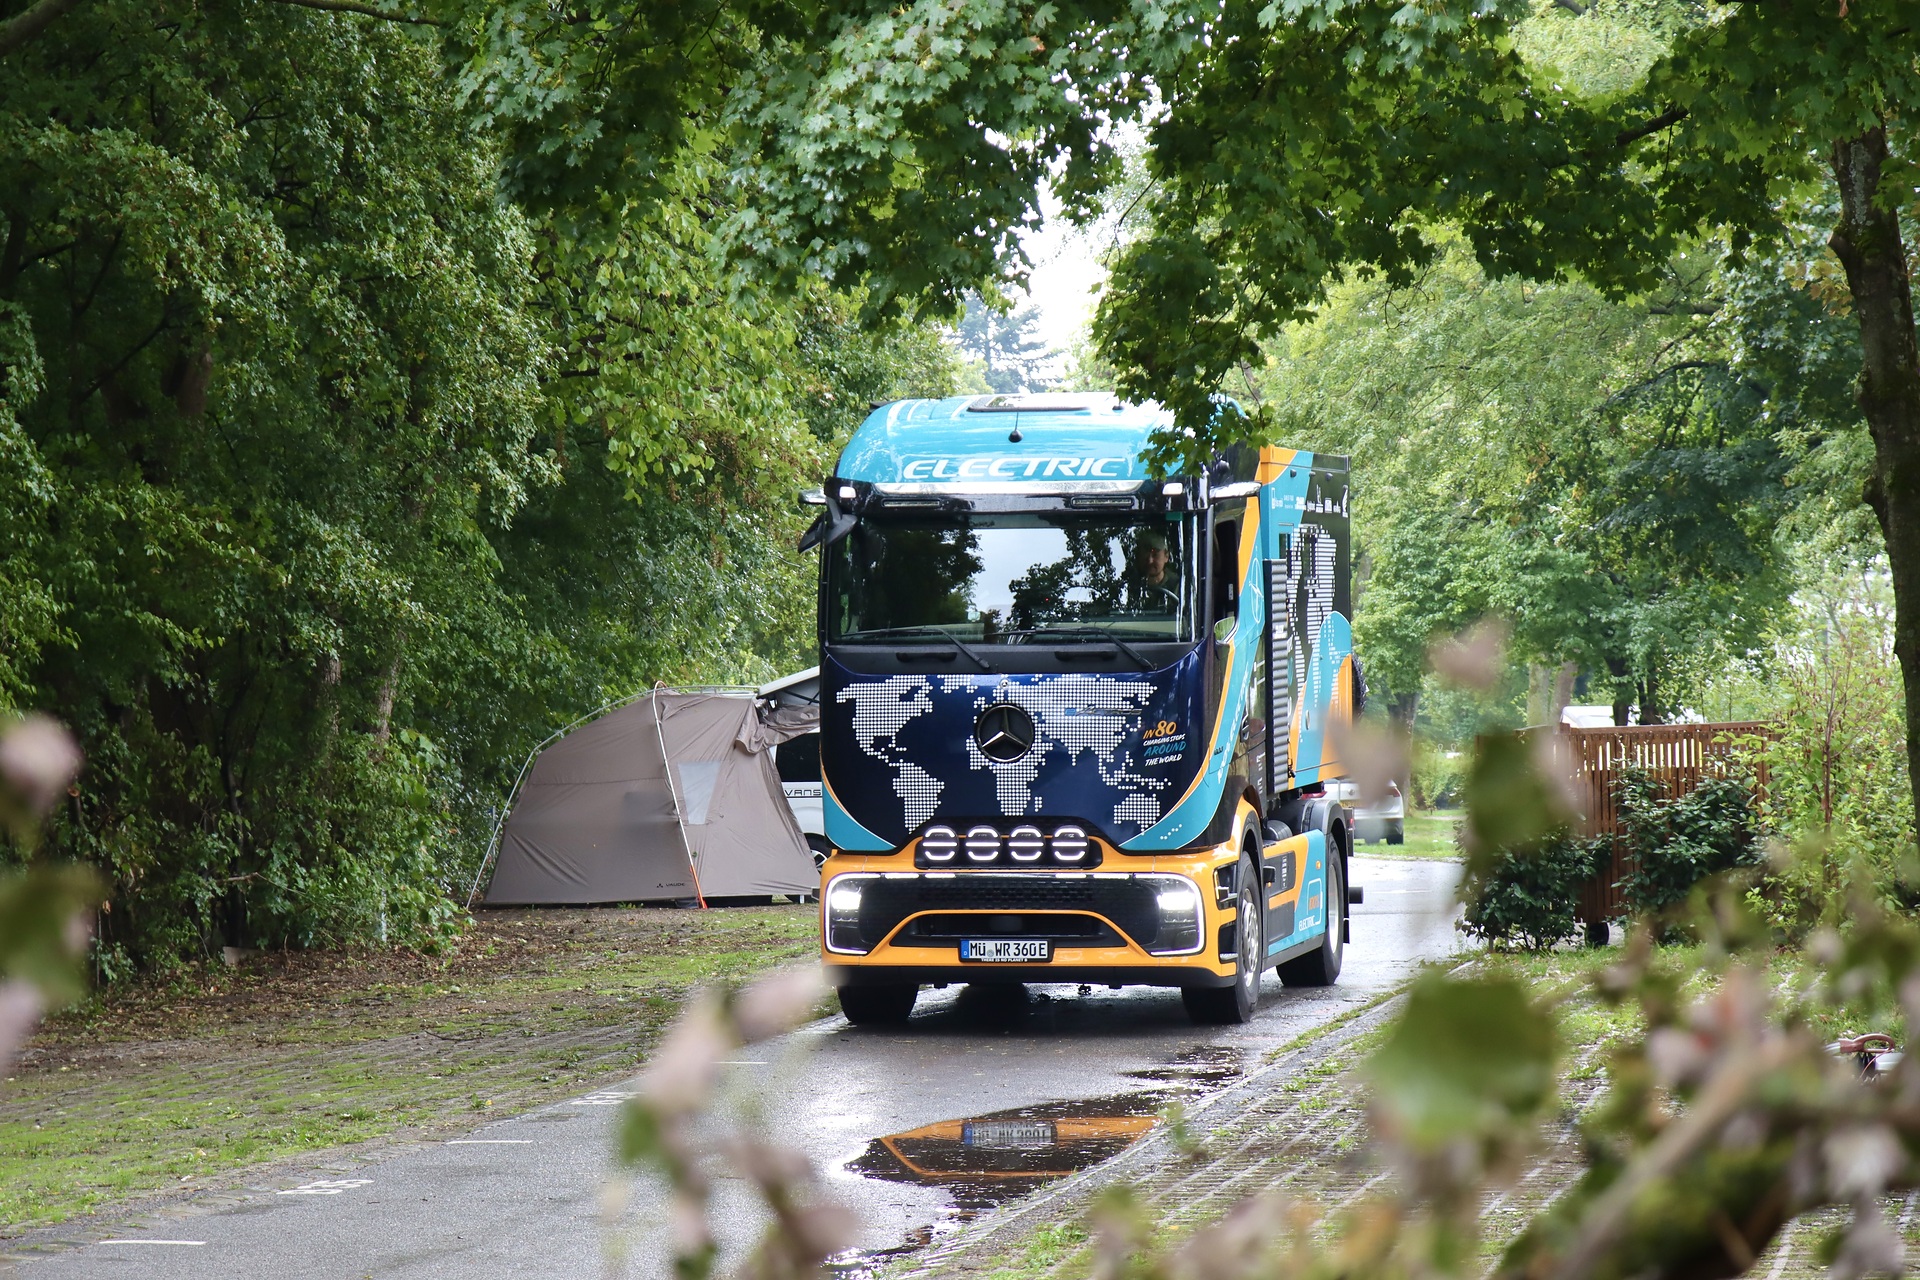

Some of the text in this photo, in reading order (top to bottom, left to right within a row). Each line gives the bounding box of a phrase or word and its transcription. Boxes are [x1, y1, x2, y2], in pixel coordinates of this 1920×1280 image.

[903, 457, 1125, 479] ELECTRIC
[1143, 720, 1177, 739] IN 80
[1143, 733, 1186, 747] CHARGING STOPS
[1144, 741, 1186, 757] AROUND
[1145, 753, 1183, 767] THE WORLD
[995, 942, 1011, 957] WR
